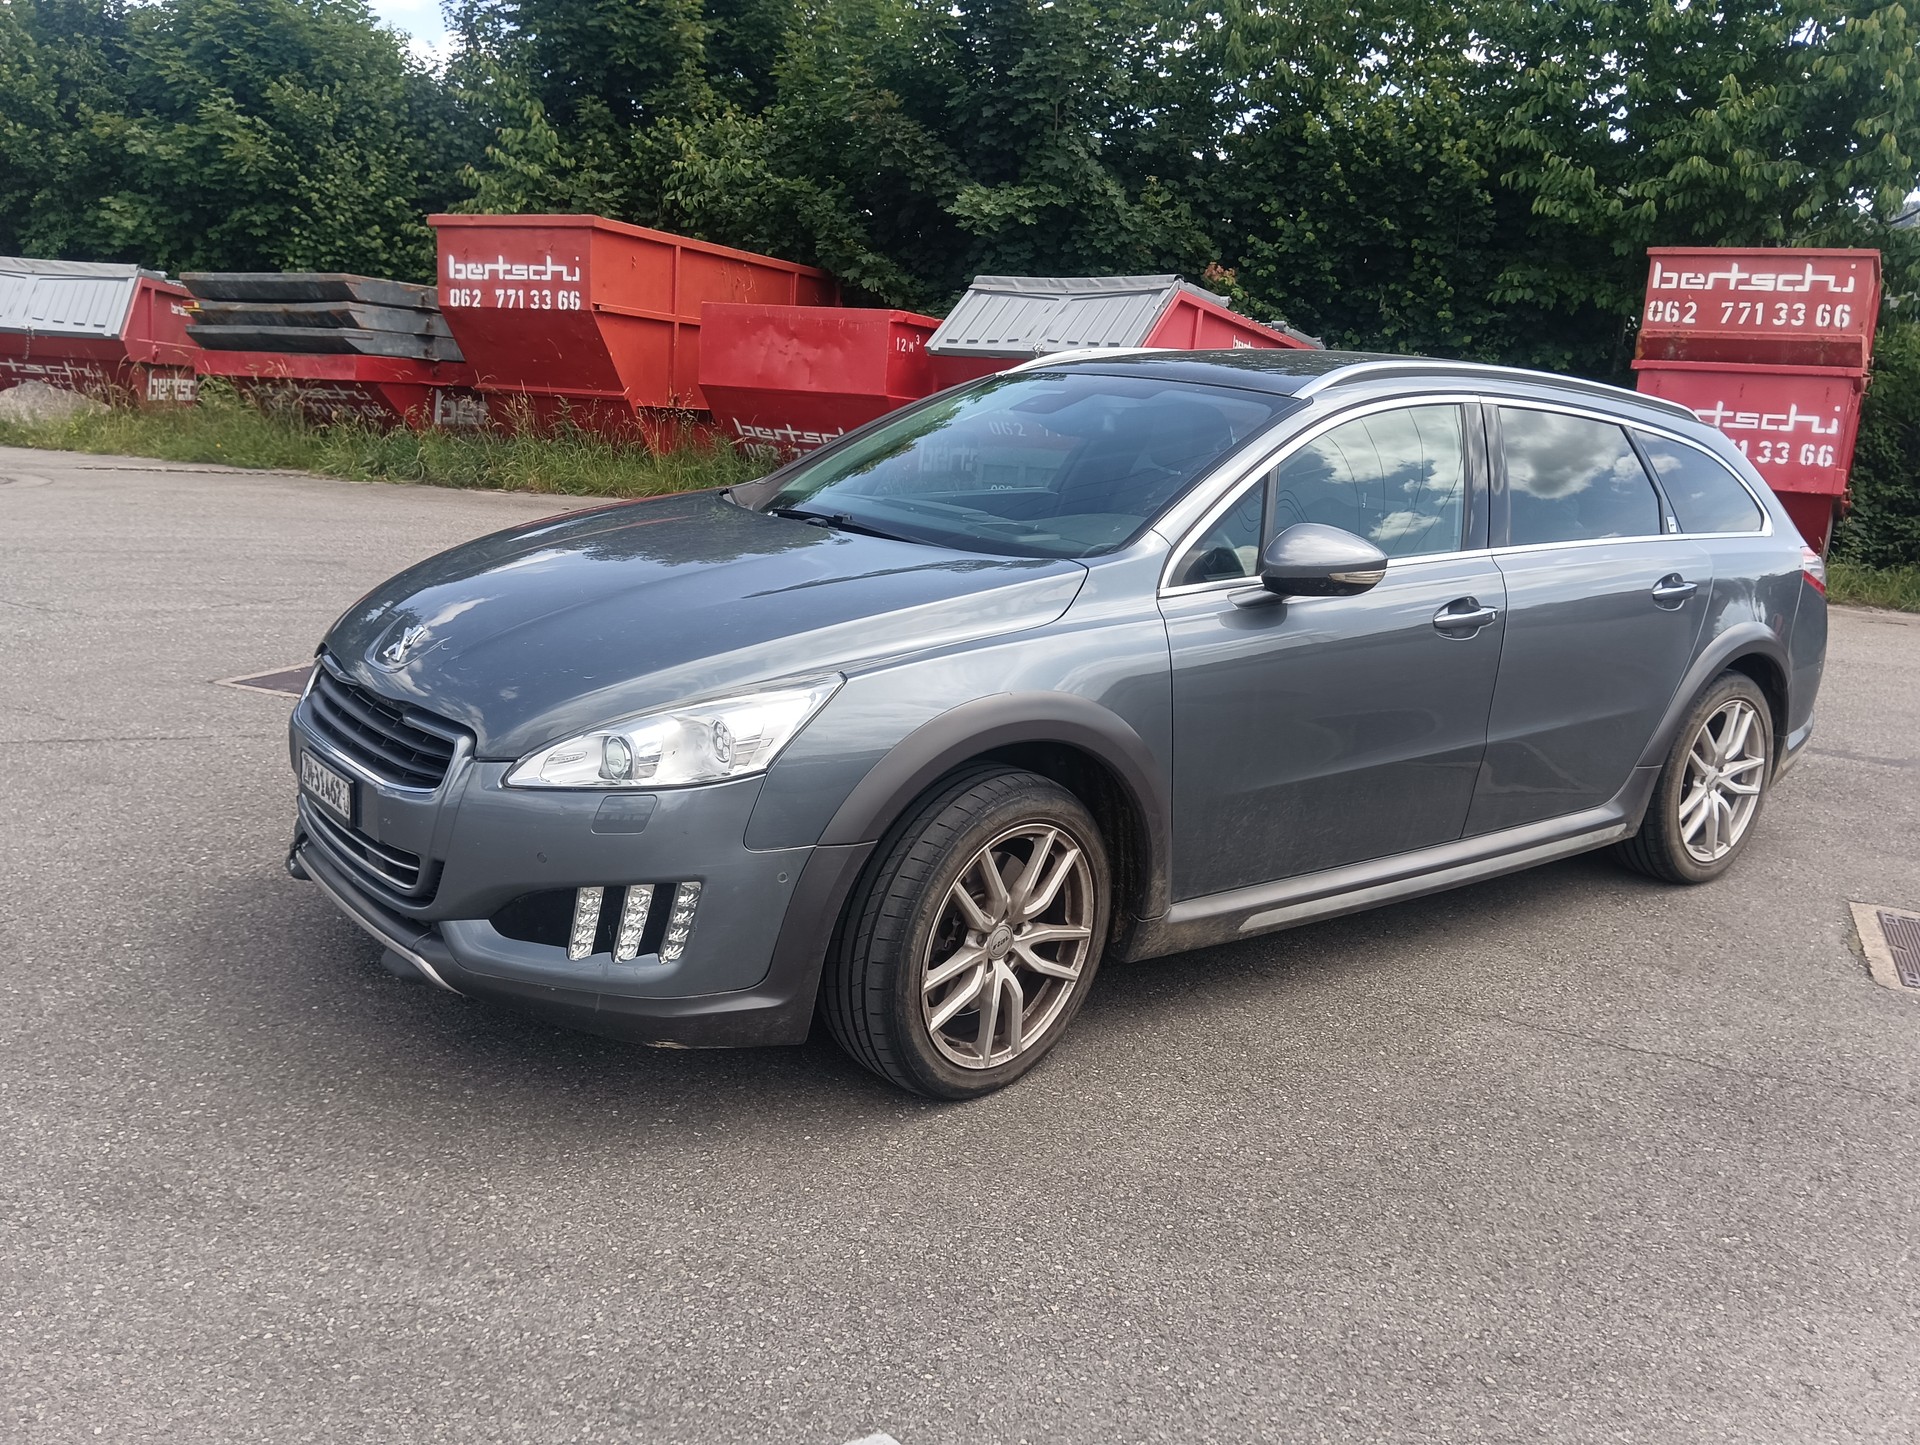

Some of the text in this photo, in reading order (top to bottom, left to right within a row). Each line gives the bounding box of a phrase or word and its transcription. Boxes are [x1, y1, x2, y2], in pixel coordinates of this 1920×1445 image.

[448, 254, 580, 281] bertschi
[1652, 261, 1856, 293] bertschi
[450, 288, 580, 310] 062 771 33 66
[1647, 300, 1851, 328] 062 771 33 66
[1756, 440, 1791, 464] 33
[1800, 443, 1834, 468] 66
